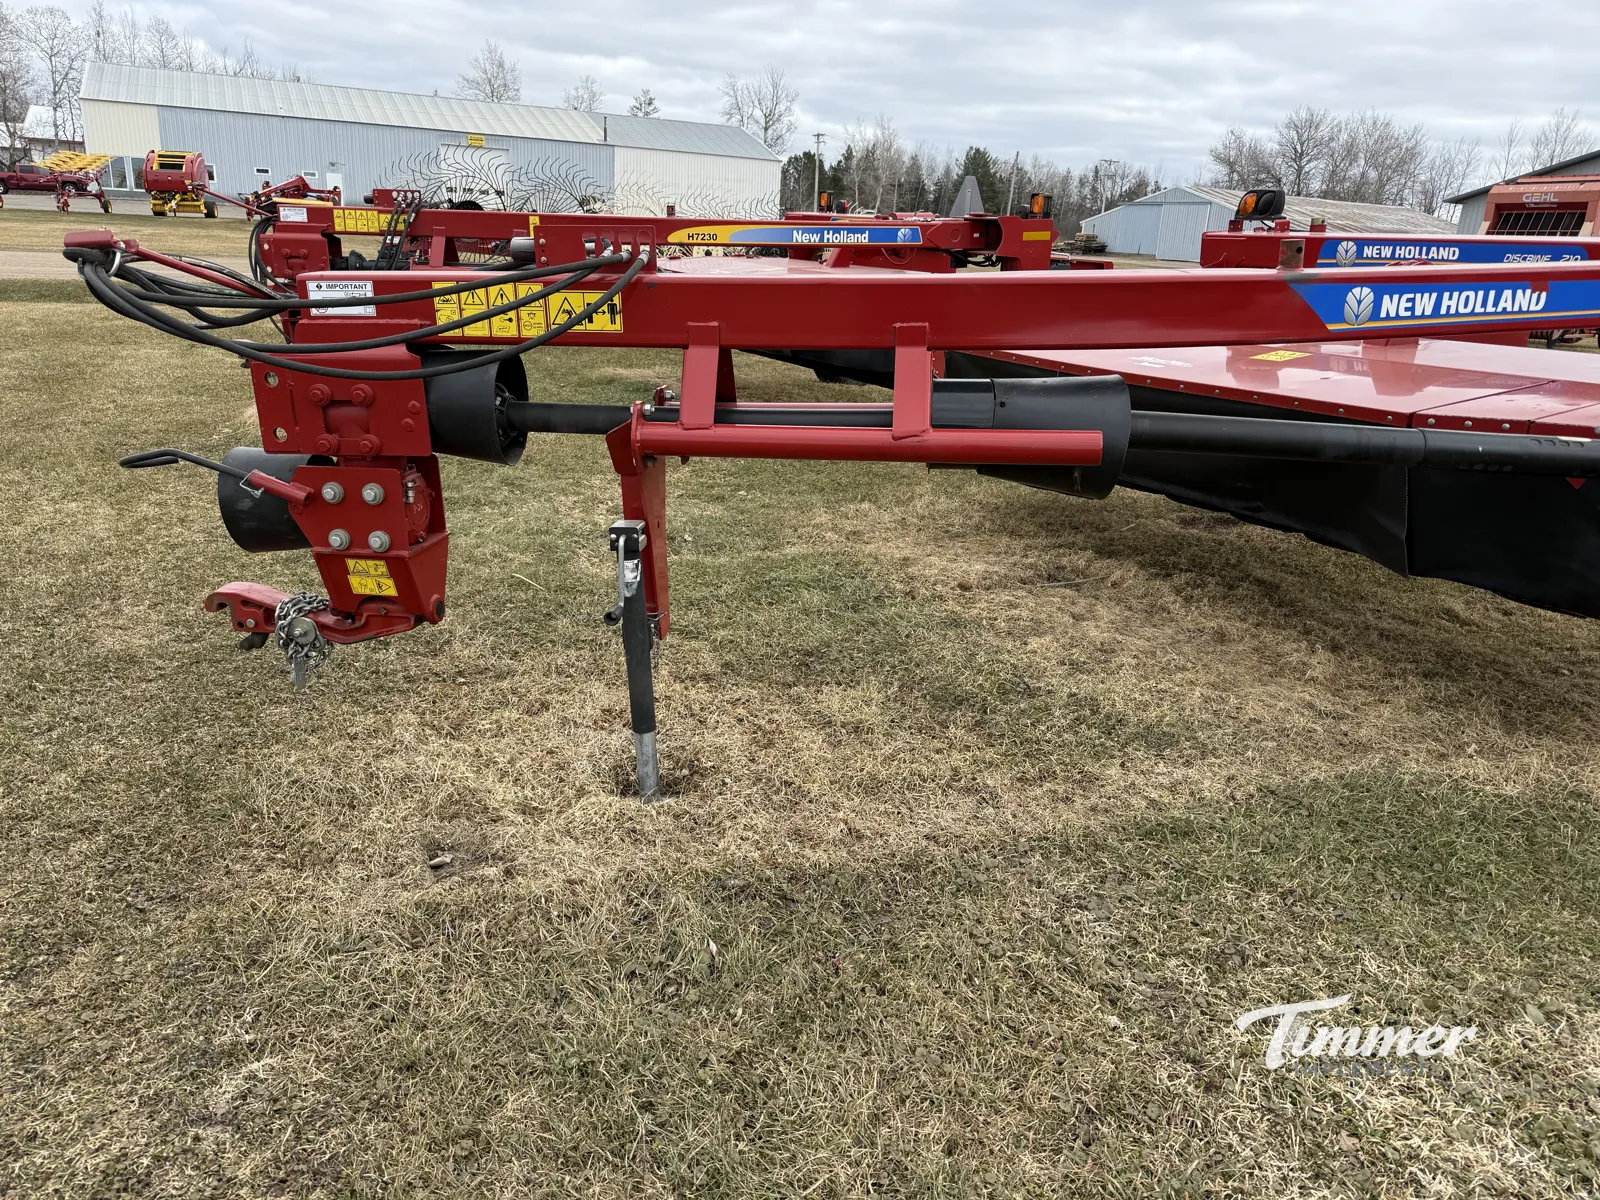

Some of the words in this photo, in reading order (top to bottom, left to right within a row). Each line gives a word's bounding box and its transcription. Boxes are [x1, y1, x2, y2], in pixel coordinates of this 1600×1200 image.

[1522, 193, 1558, 202] GEHL
[687, 232, 718, 241] H7230
[792, 230, 822, 243] New
[823, 230, 869, 243] Holland
[1362, 245, 1396, 259] NEW
[1395, 246, 1459, 260] HOLLAND
[1503, 253, 1552, 263] DISCBINE
[1379, 292, 1440, 318] NEW
[1440, 288, 1547, 315] HOLLAND
